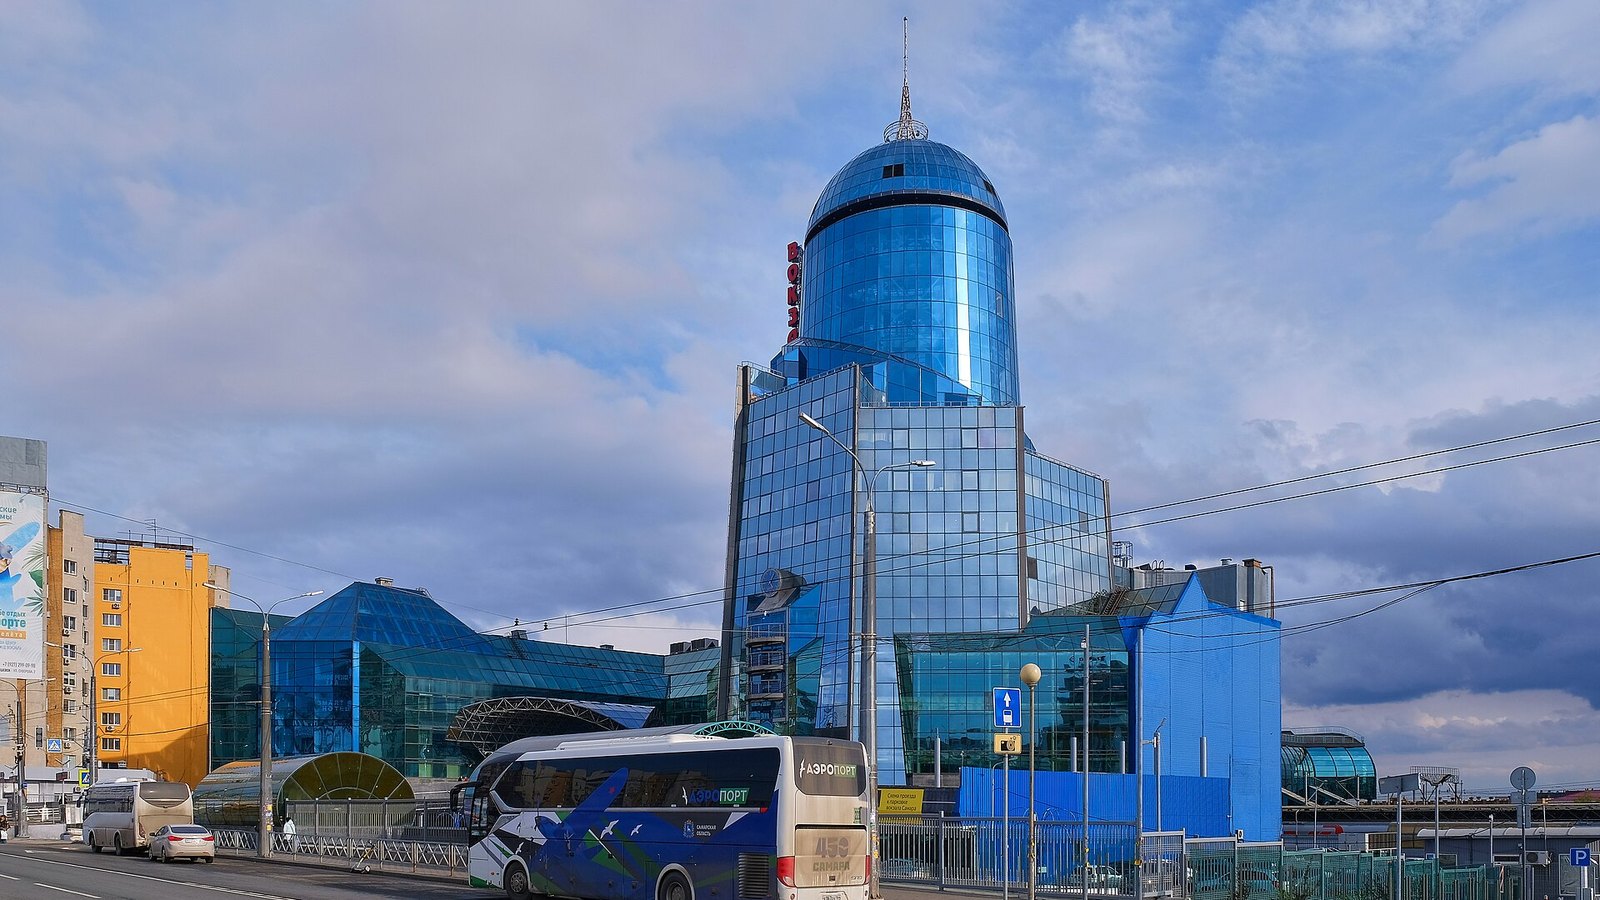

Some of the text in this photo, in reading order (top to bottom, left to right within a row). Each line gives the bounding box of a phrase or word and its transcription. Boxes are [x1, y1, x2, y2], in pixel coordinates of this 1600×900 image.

[806, 763, 856, 776] АЭРОПОРТ
[689, 789, 747, 803] АЭРОПОРТ
[1575, 850, 1587, 865] P
[813, 862, 850, 871] САМАРА
